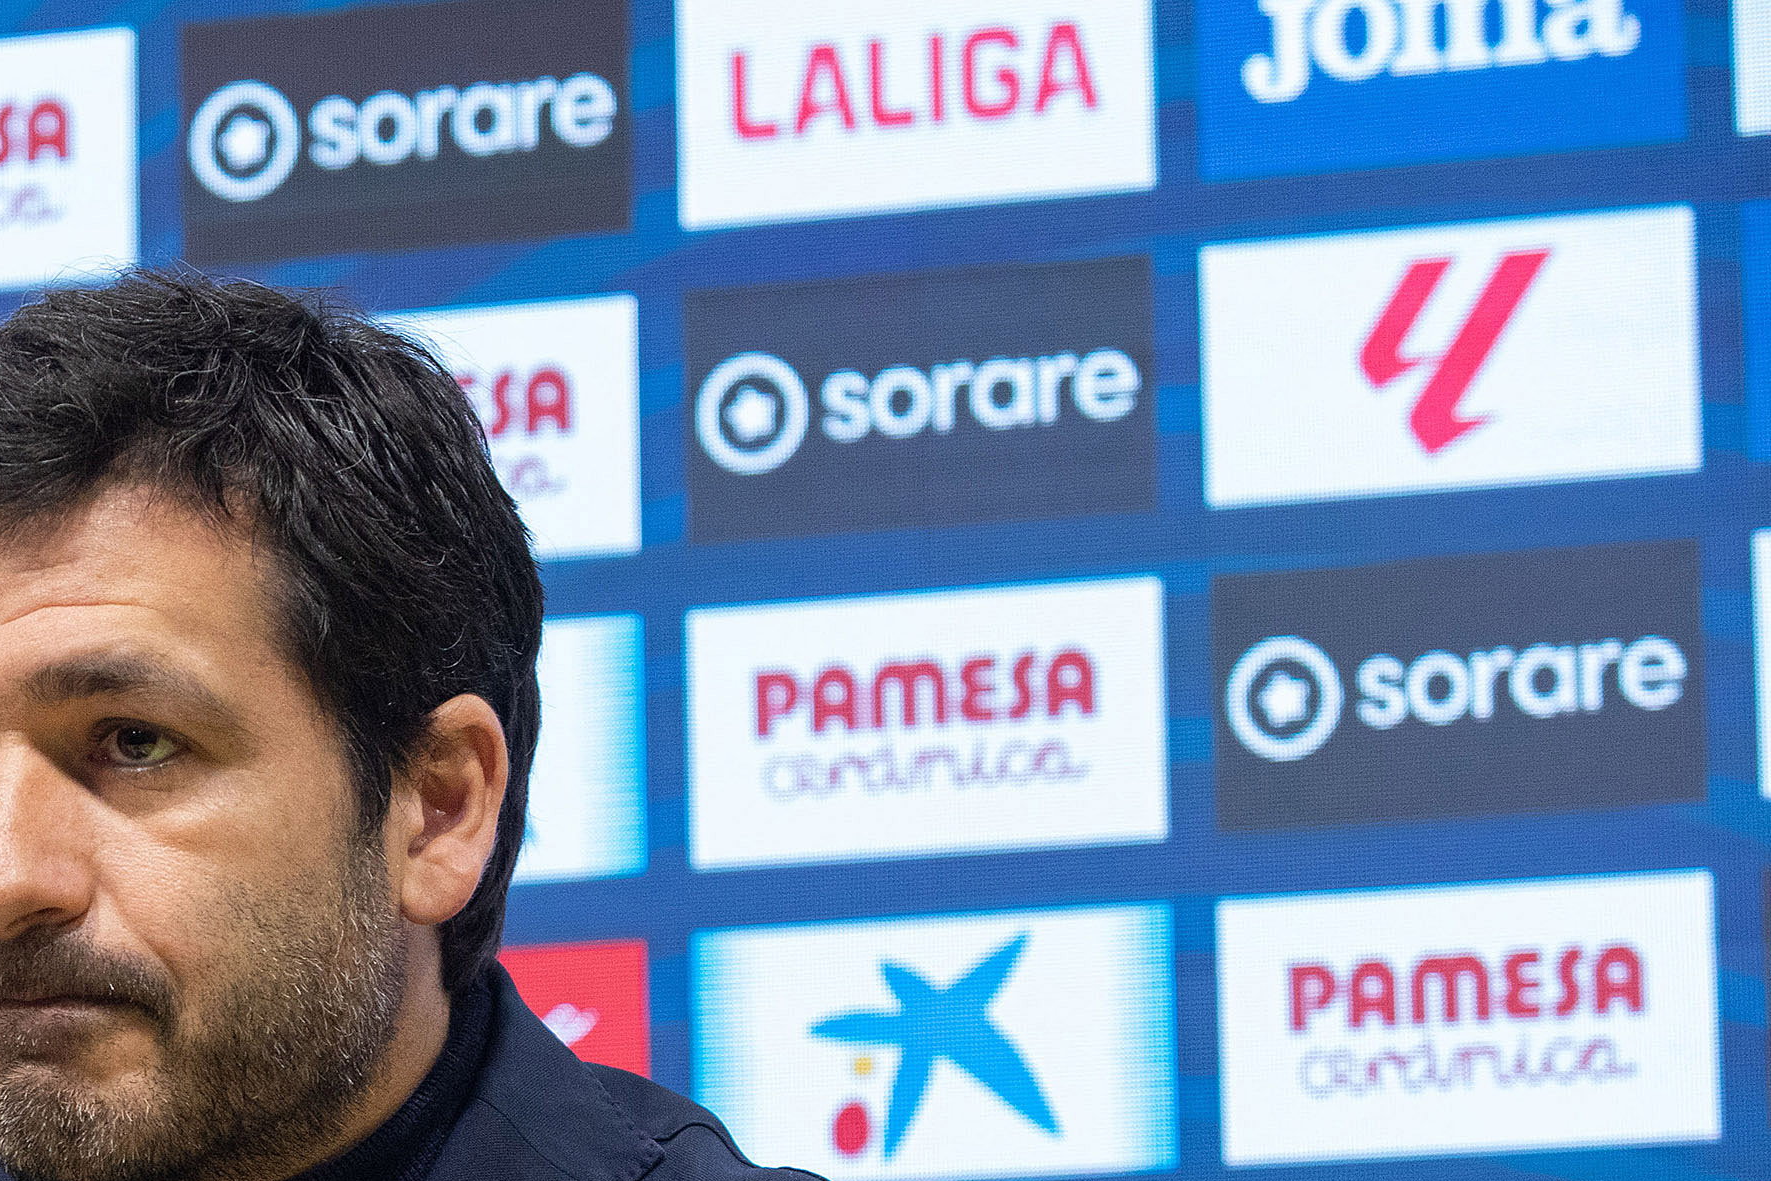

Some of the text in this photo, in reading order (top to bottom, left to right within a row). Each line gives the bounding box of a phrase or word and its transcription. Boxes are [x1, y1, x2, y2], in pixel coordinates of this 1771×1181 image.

[309, 73, 617, 169] sorare
[731, 22, 1097, 141] LALIGA
[822, 350, 1140, 441] sorare
[755, 649, 1096, 738] PAMESA
[1357, 636, 1686, 729] sorare
[1289, 945, 1644, 1032] PAMESA
